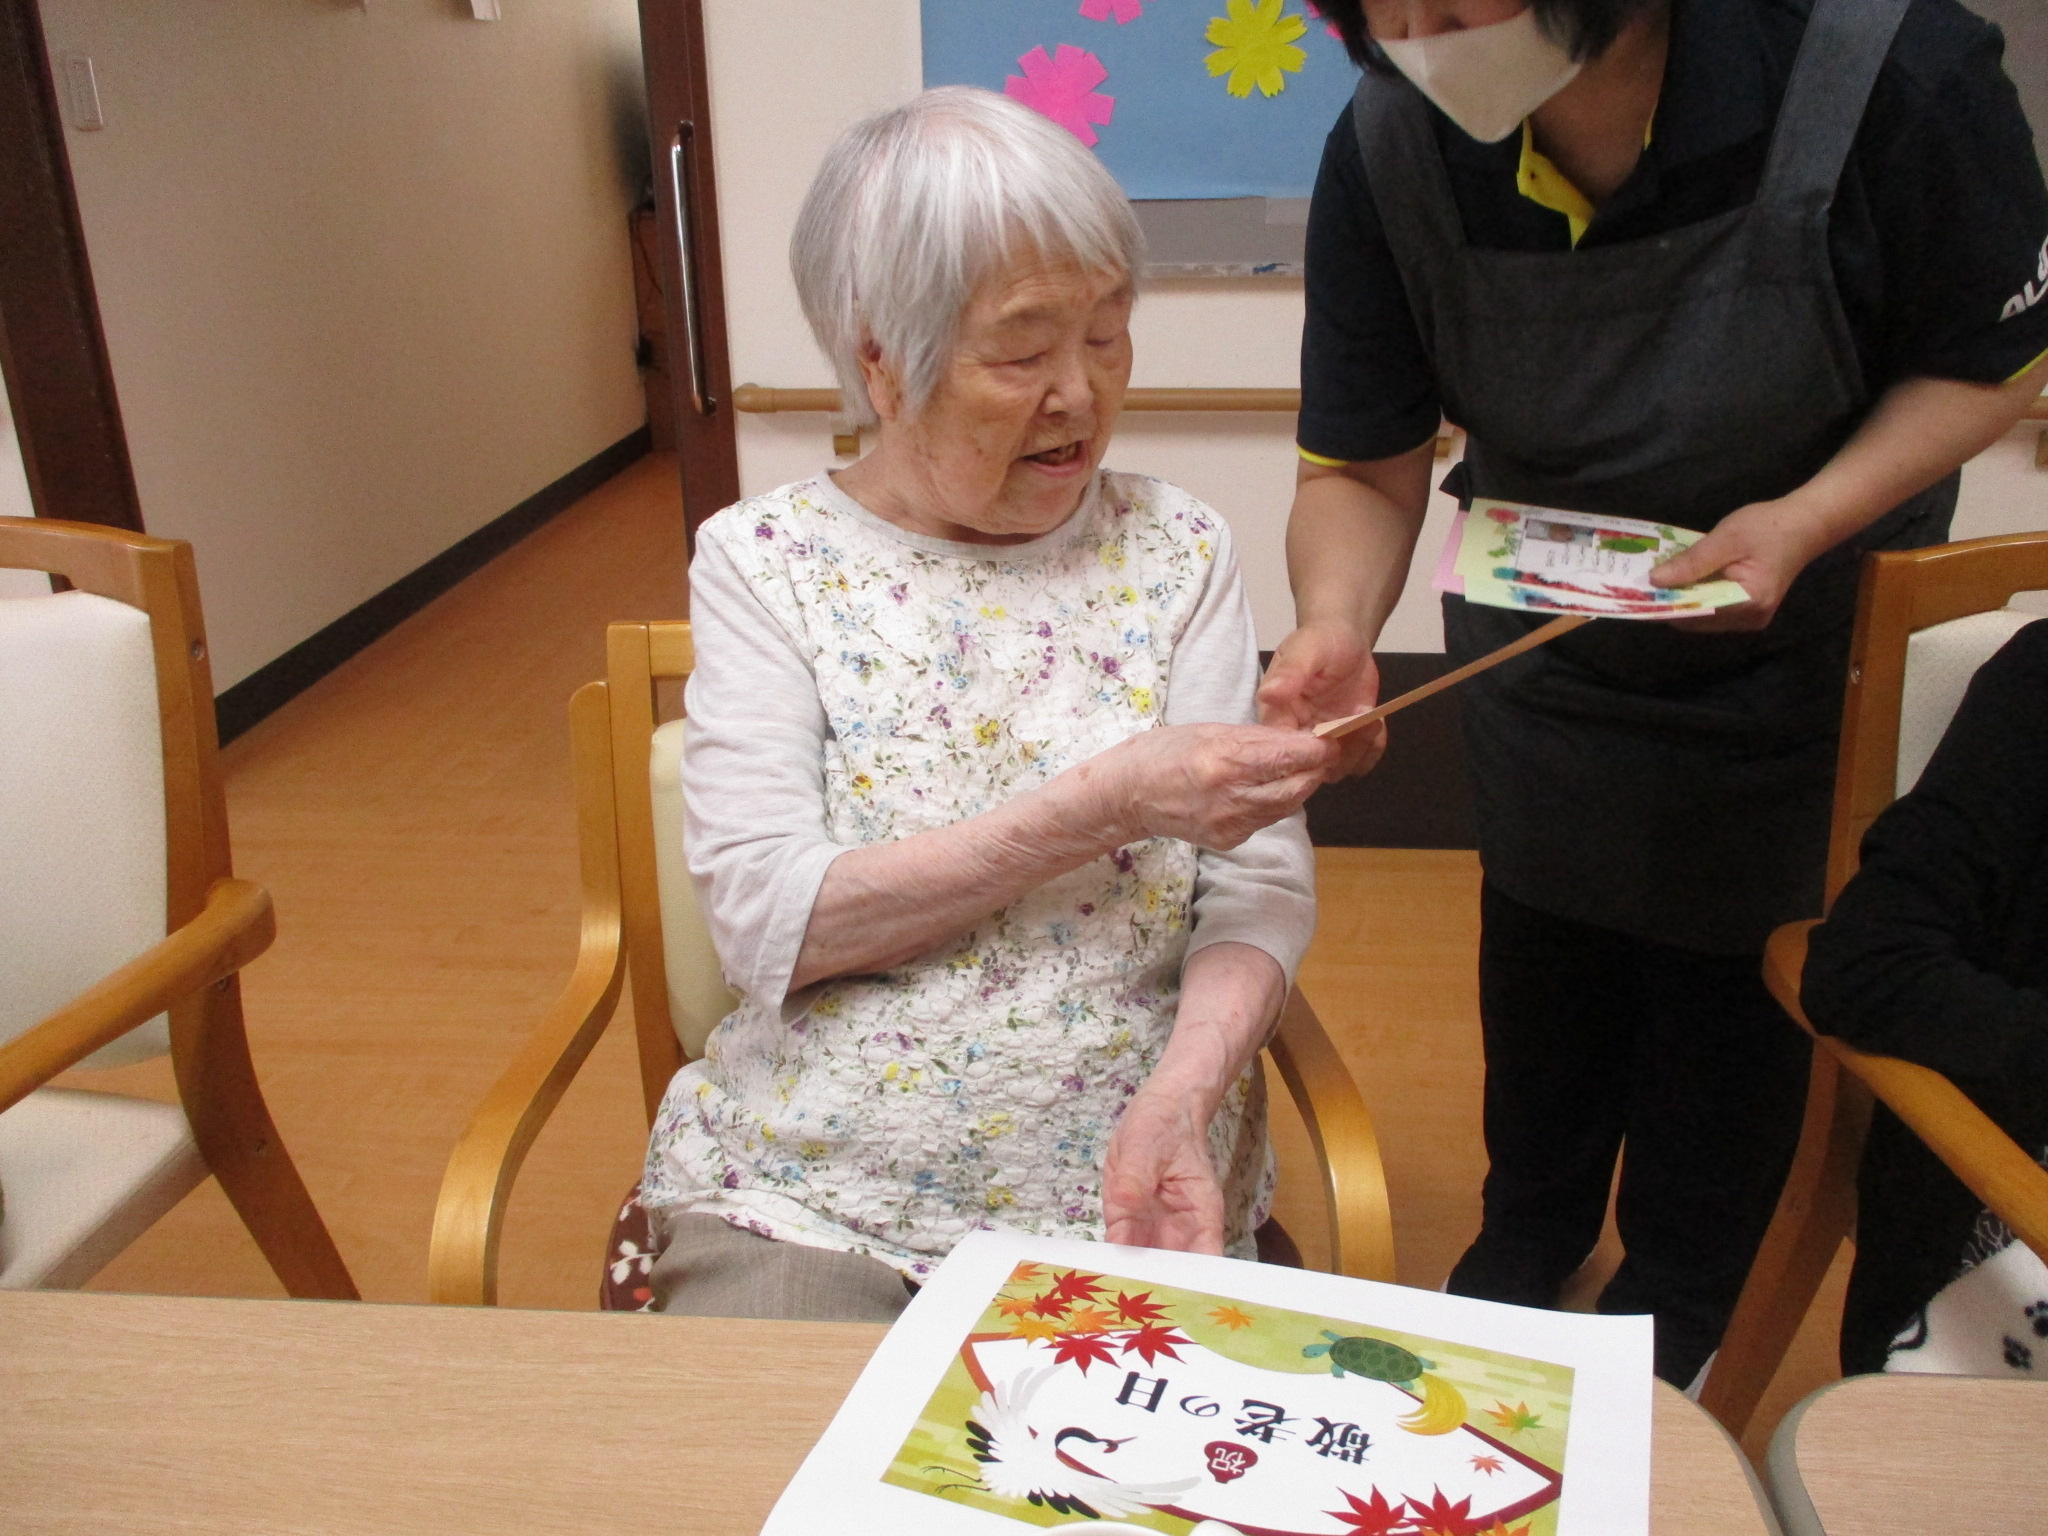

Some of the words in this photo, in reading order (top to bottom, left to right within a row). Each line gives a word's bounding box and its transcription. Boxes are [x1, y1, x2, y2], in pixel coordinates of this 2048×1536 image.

[1115, 1371, 1375, 1465] 敬老の日
[1211, 1447, 1246, 1475] 祝
